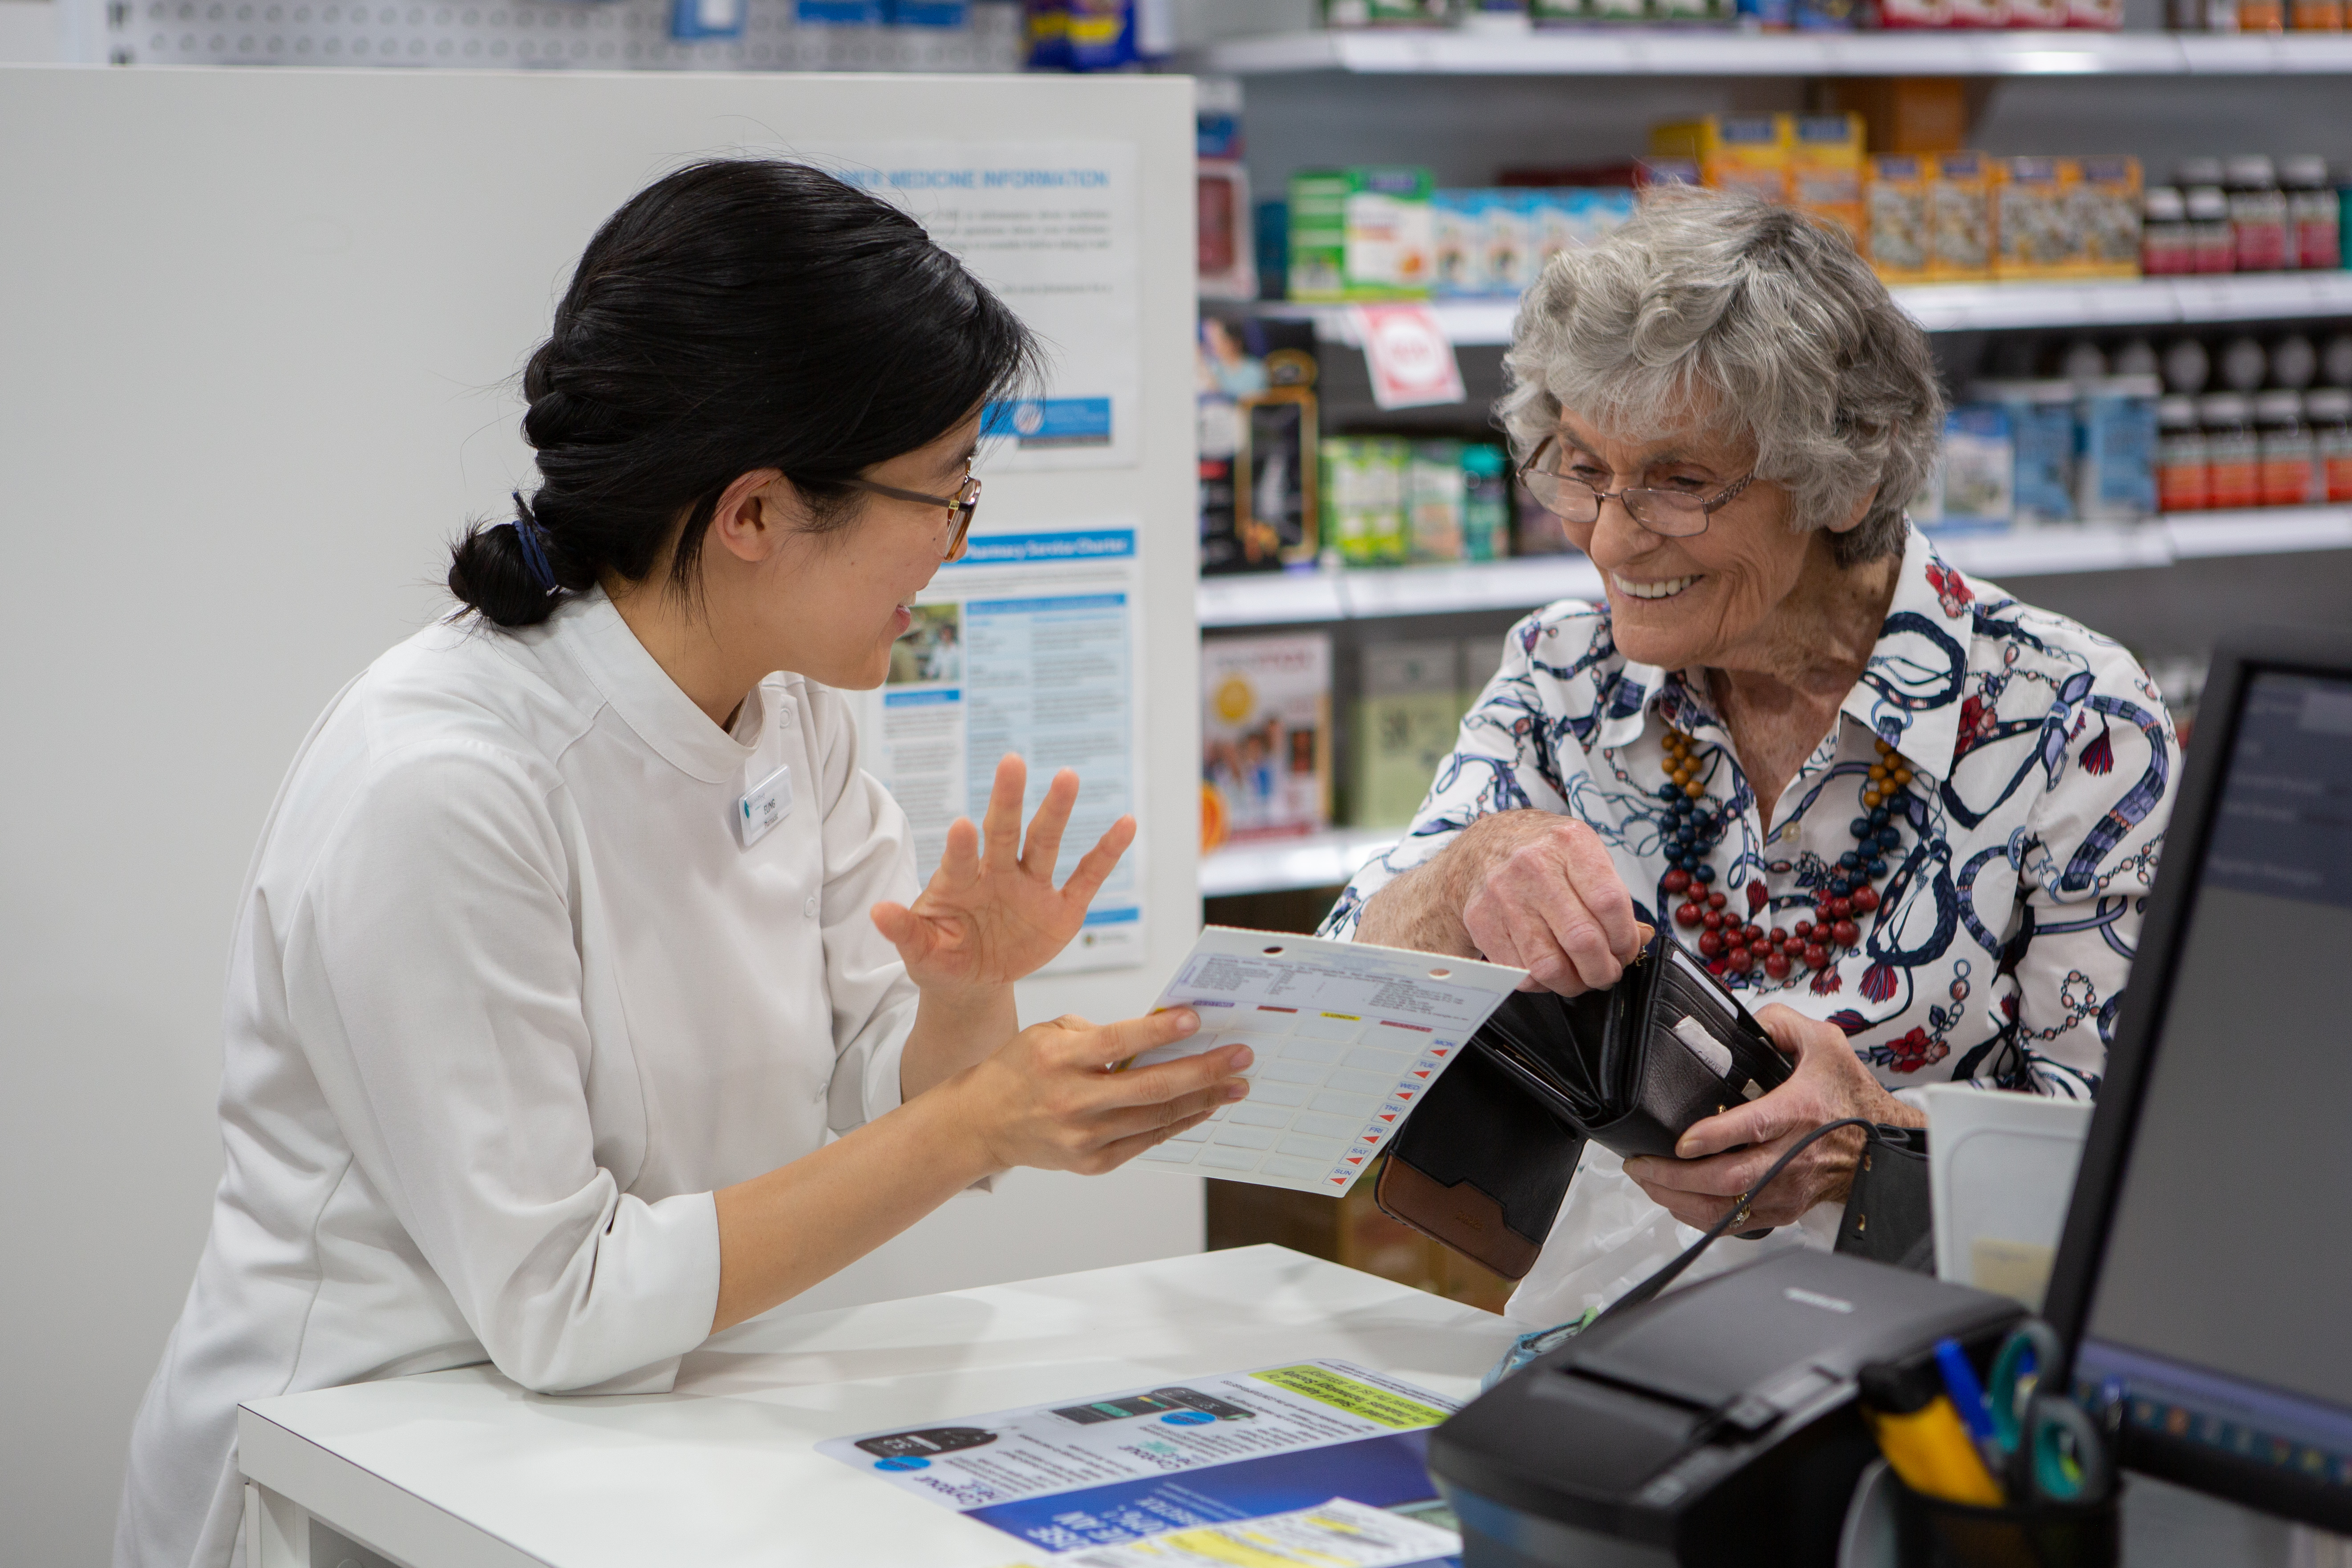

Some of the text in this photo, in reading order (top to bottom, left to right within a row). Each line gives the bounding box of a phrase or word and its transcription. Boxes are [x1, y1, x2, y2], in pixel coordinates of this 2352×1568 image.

[983, 169, 1110, 189] INFORMATION
[1281, 1370, 1318, 1384] Society
[1315, 1382, 1368, 1402] Technology
[1367, 1401, 1411, 1418] Diabetes
[1390, 1400, 1423, 1414] topped
[1422, 1411, 1443, 1419] and
[1363, 1409, 1409, 1425] Awarded
